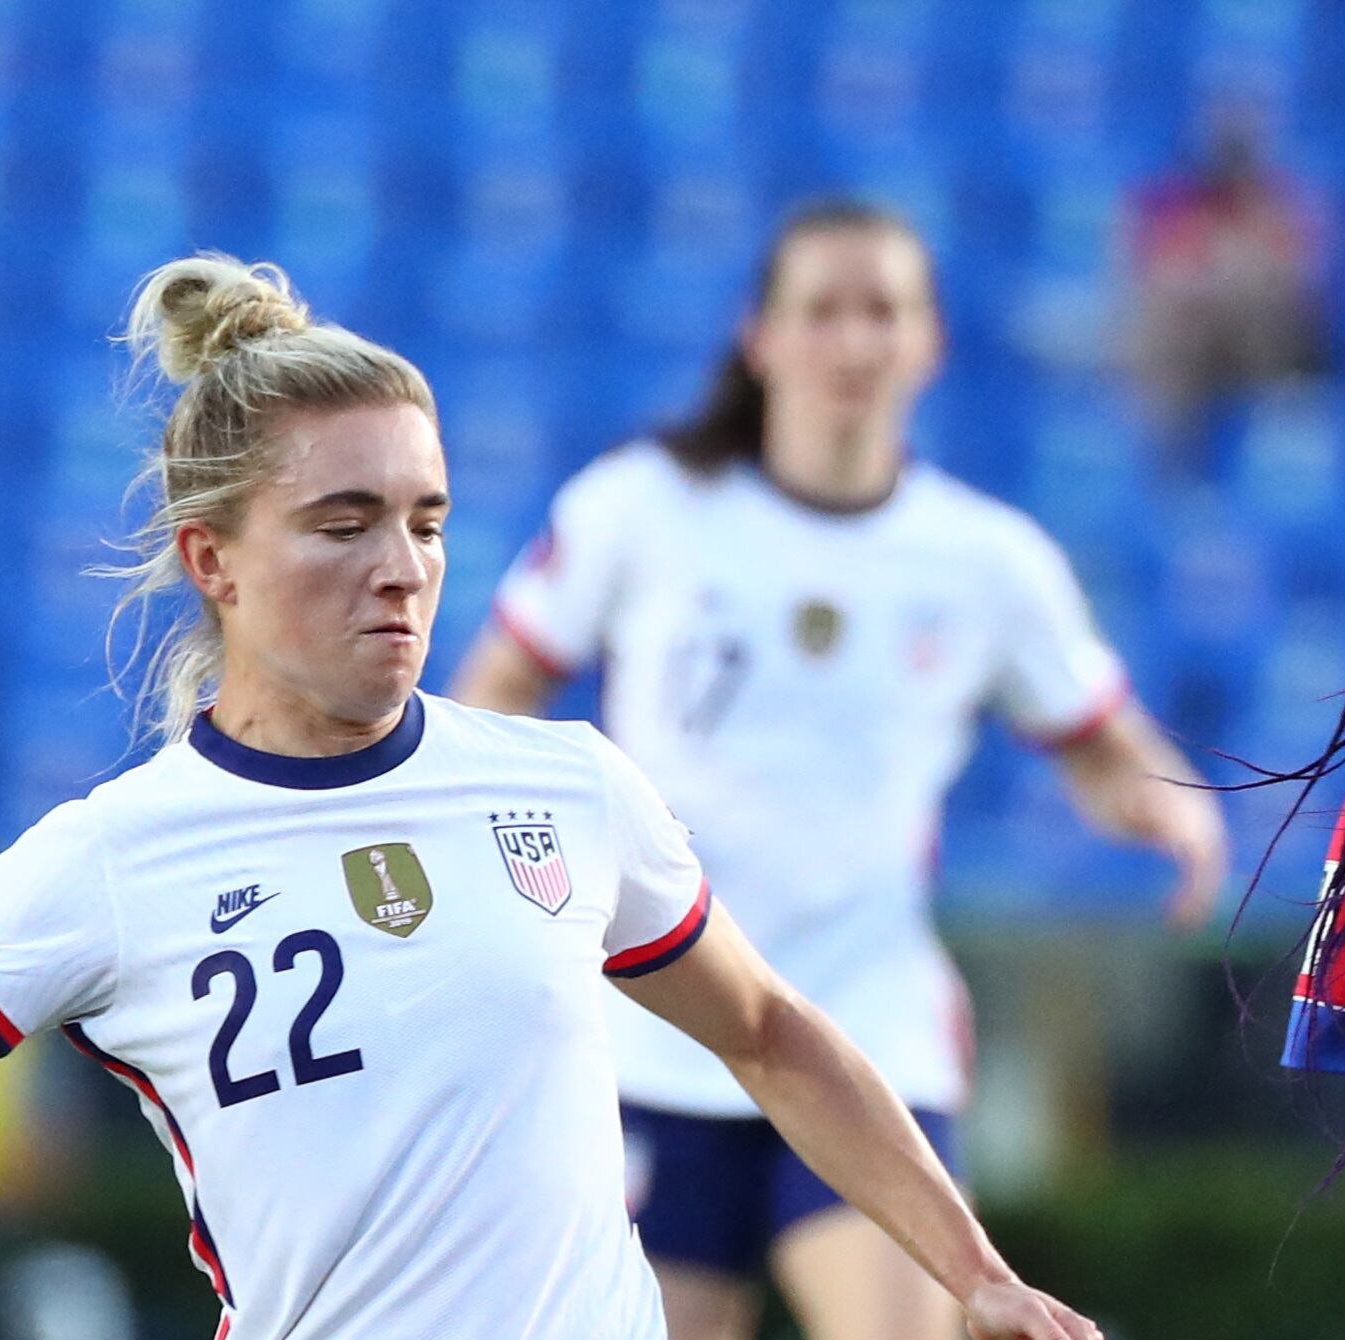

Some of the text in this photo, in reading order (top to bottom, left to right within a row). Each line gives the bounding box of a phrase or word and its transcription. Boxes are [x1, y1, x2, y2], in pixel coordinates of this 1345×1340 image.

[502, 831, 556, 863] USA
[217, 884, 261, 917] NIKE
[376, 899, 417, 918] FIFA
[191, 929, 363, 1108] 22
